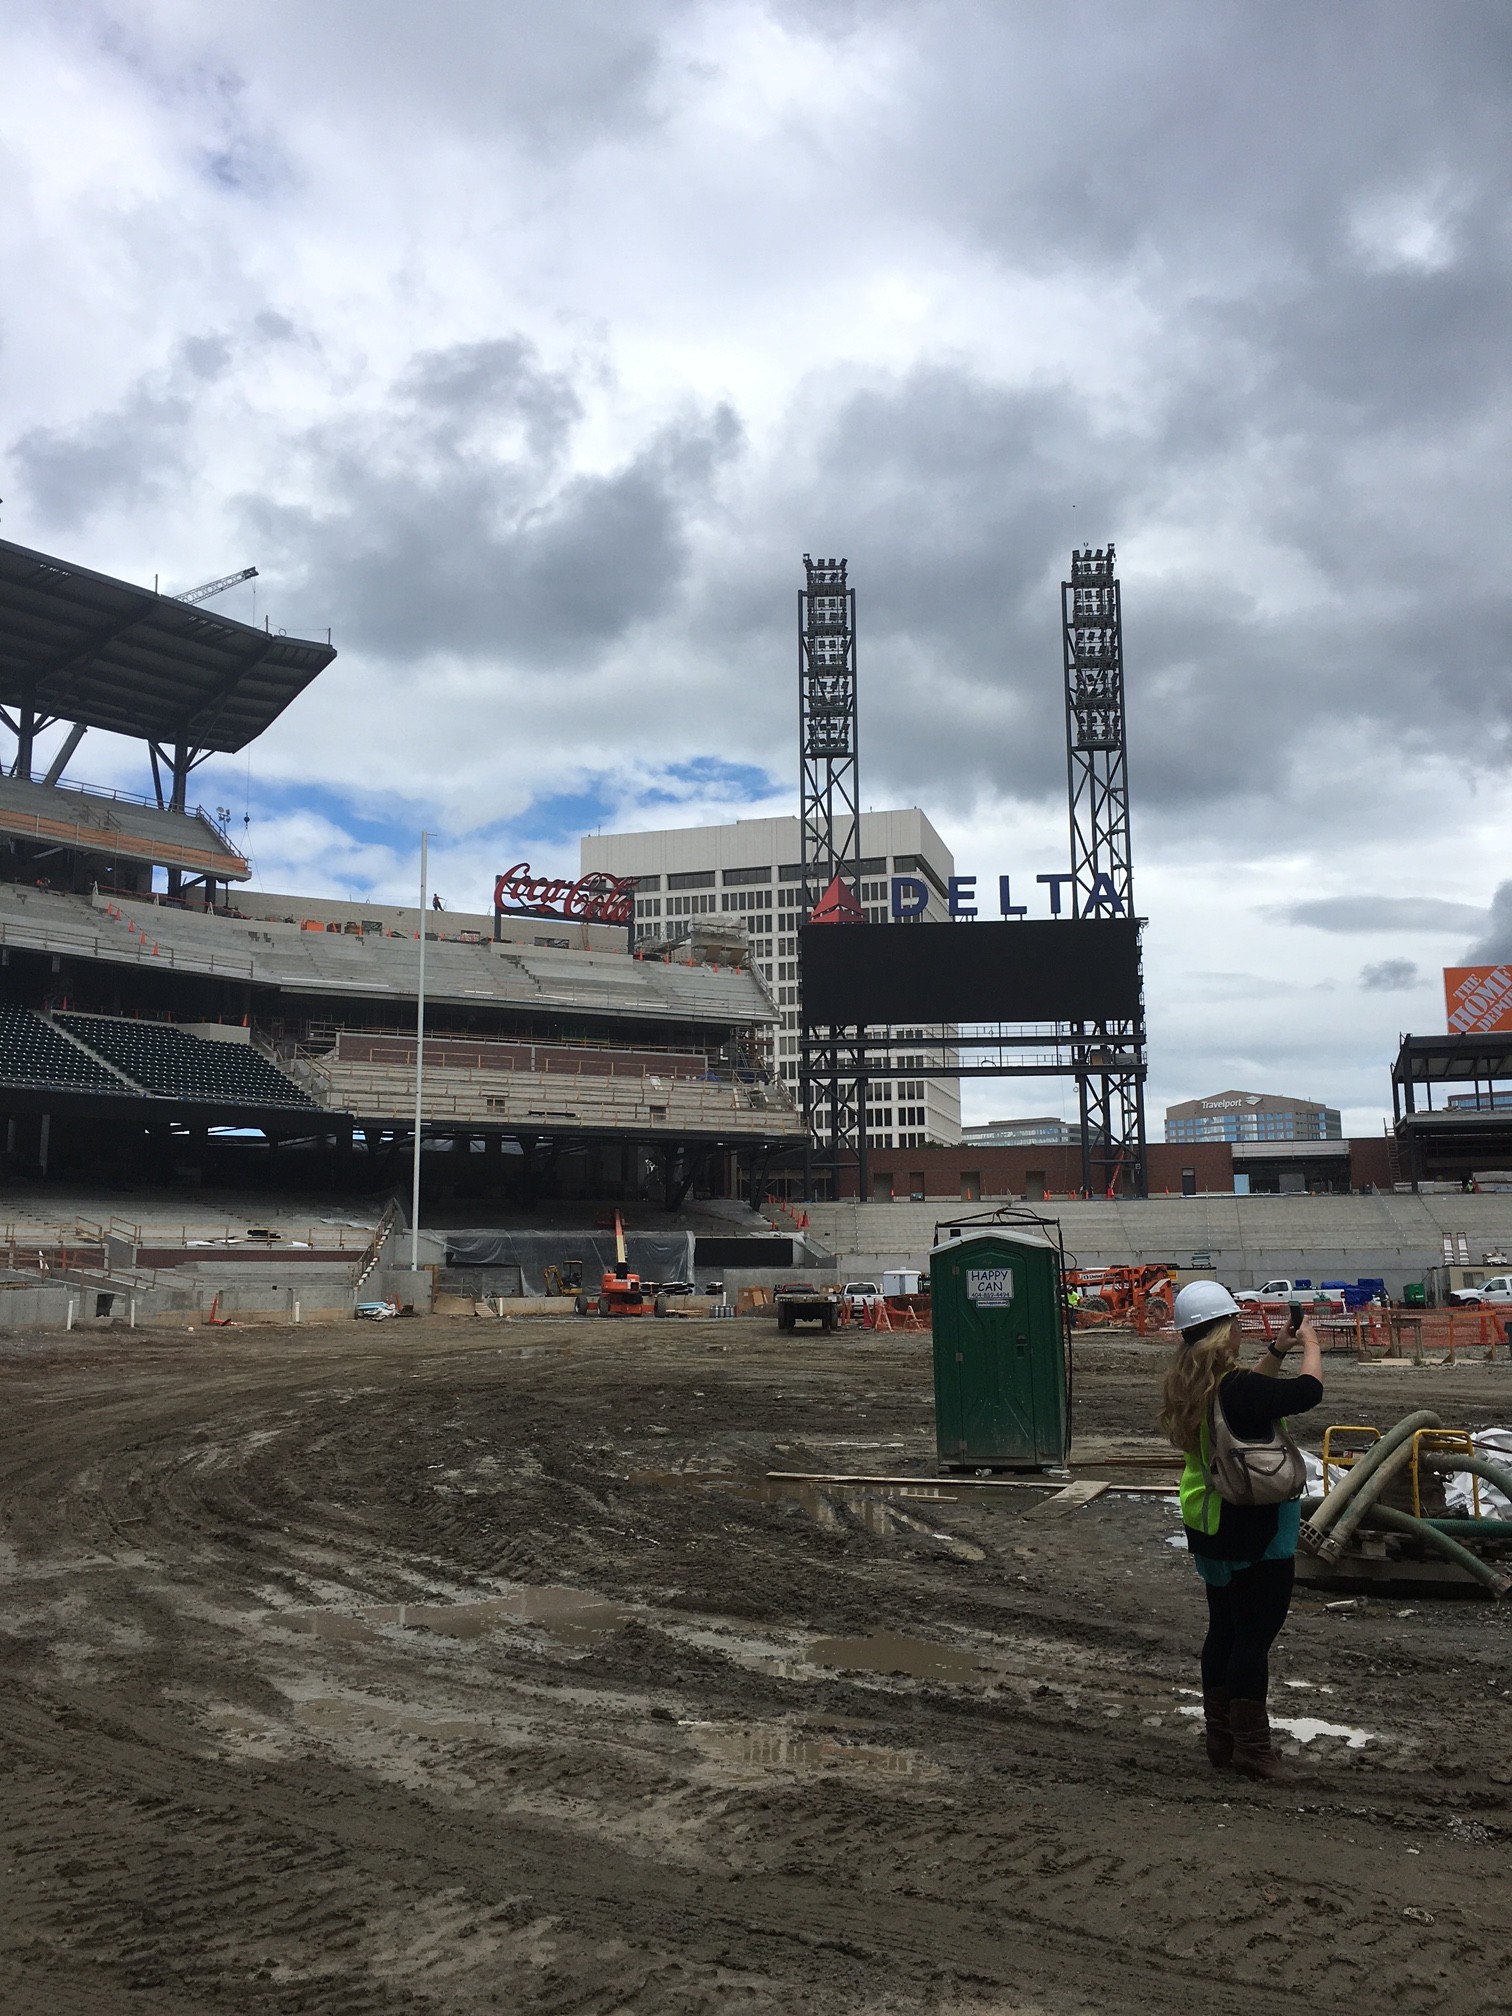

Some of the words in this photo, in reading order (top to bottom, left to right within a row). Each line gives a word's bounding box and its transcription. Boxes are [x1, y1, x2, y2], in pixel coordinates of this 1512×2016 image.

[891, 872, 1126, 917] DELTA
[1453, 973, 1481, 1000] THE
[1476, 988, 1512, 1032] DEPO
[1201, 1099, 1242, 1109] Travelport
[971, 1270, 1008, 1281] HAPPY
[977, 1281, 1003, 1291] CAN
